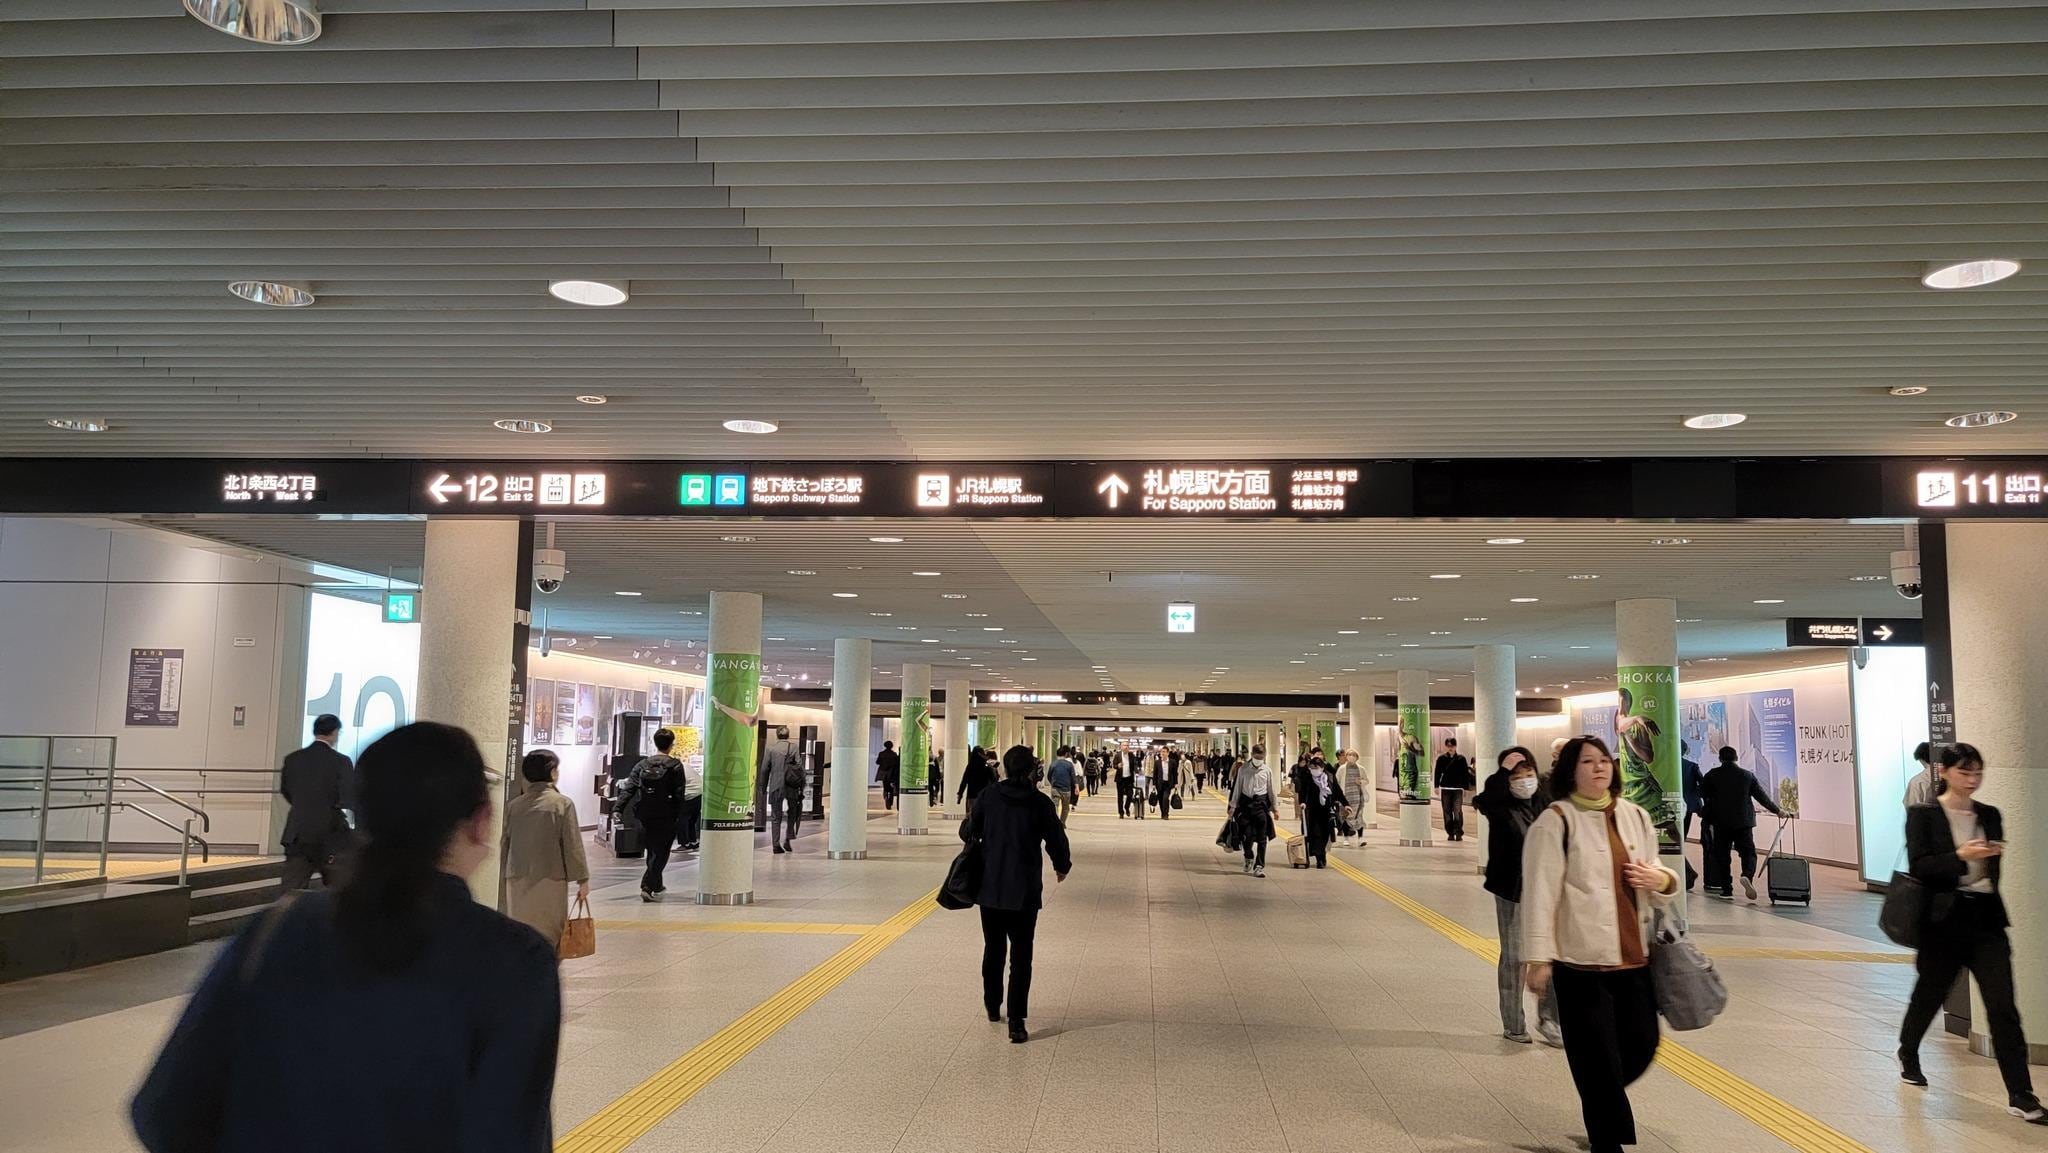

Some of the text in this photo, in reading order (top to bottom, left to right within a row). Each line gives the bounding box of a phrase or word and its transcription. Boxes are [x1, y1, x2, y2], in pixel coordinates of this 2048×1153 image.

[224, 475, 316, 491] 北1条西4丁目
[464, 475, 498, 502] 12
[503, 476, 534, 491] 出口
[752, 477, 862, 493] 地下鉄さっぽろ駅
[955, 477, 1022, 494] JR札幌駅
[1143, 469, 1270, 495] 札幌駅方面
[1961, 474, 1998, 503] 11
[2005, 475, 2041, 492] 出口
[225, 491, 251, 500] North
[275, 491, 299, 500] West
[503, 492, 534, 501] Exit 12
[753, 494, 860, 504] Sapporo Subway Station
[956, 494, 1042, 504] JR Sapporo Station
[2005, 493, 2040, 503] Exit 11
[1143, 496, 1276, 512] For Sapporo Station
